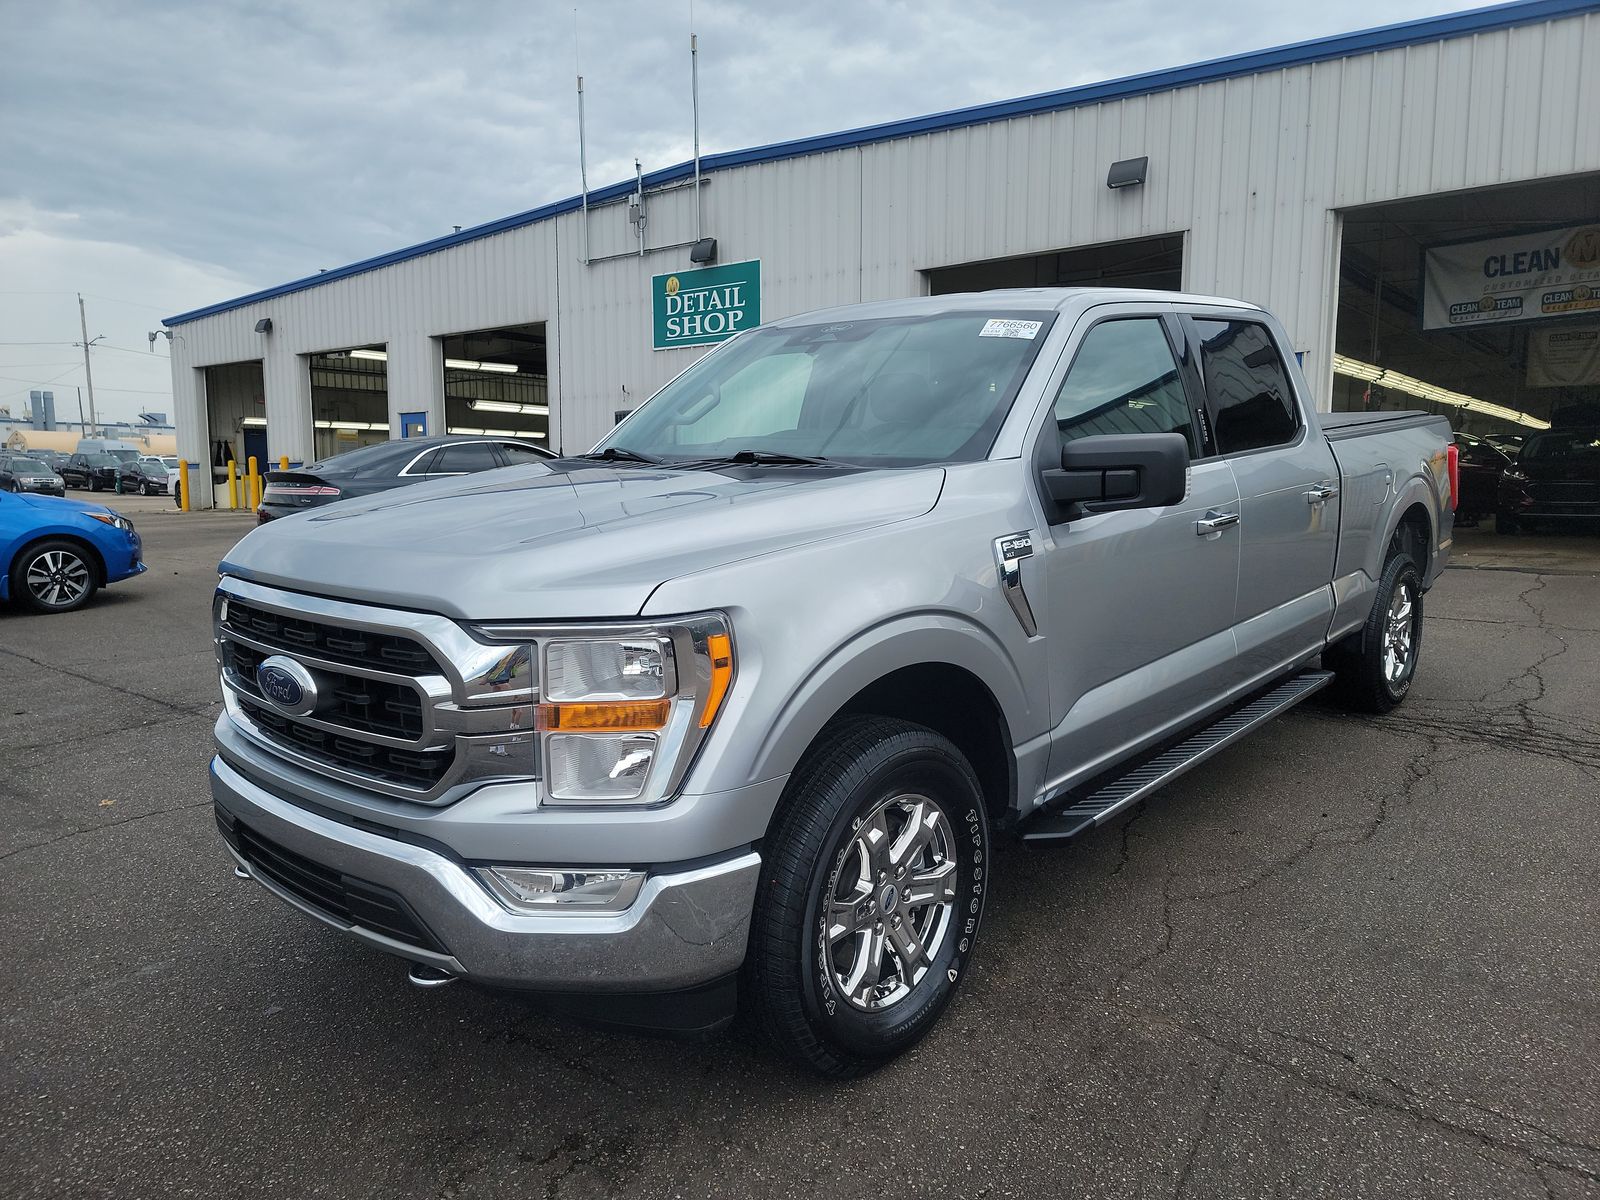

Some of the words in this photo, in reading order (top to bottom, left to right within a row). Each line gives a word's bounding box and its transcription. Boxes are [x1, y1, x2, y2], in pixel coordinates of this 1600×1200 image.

[1484, 248, 1560, 278] CLEAN
[665, 287, 746, 316] DETAIL
[1451, 303, 1478, 314] CLEAN
[1496, 299, 1521, 309] TEAM
[1543, 292, 1572, 304] CLEAN
[666, 310, 743, 338] SHOP
[990, 321, 1038, 329] 7766560
[1002, 538, 1031, 552] F-150
[265, 671, 292, 700] Ford
